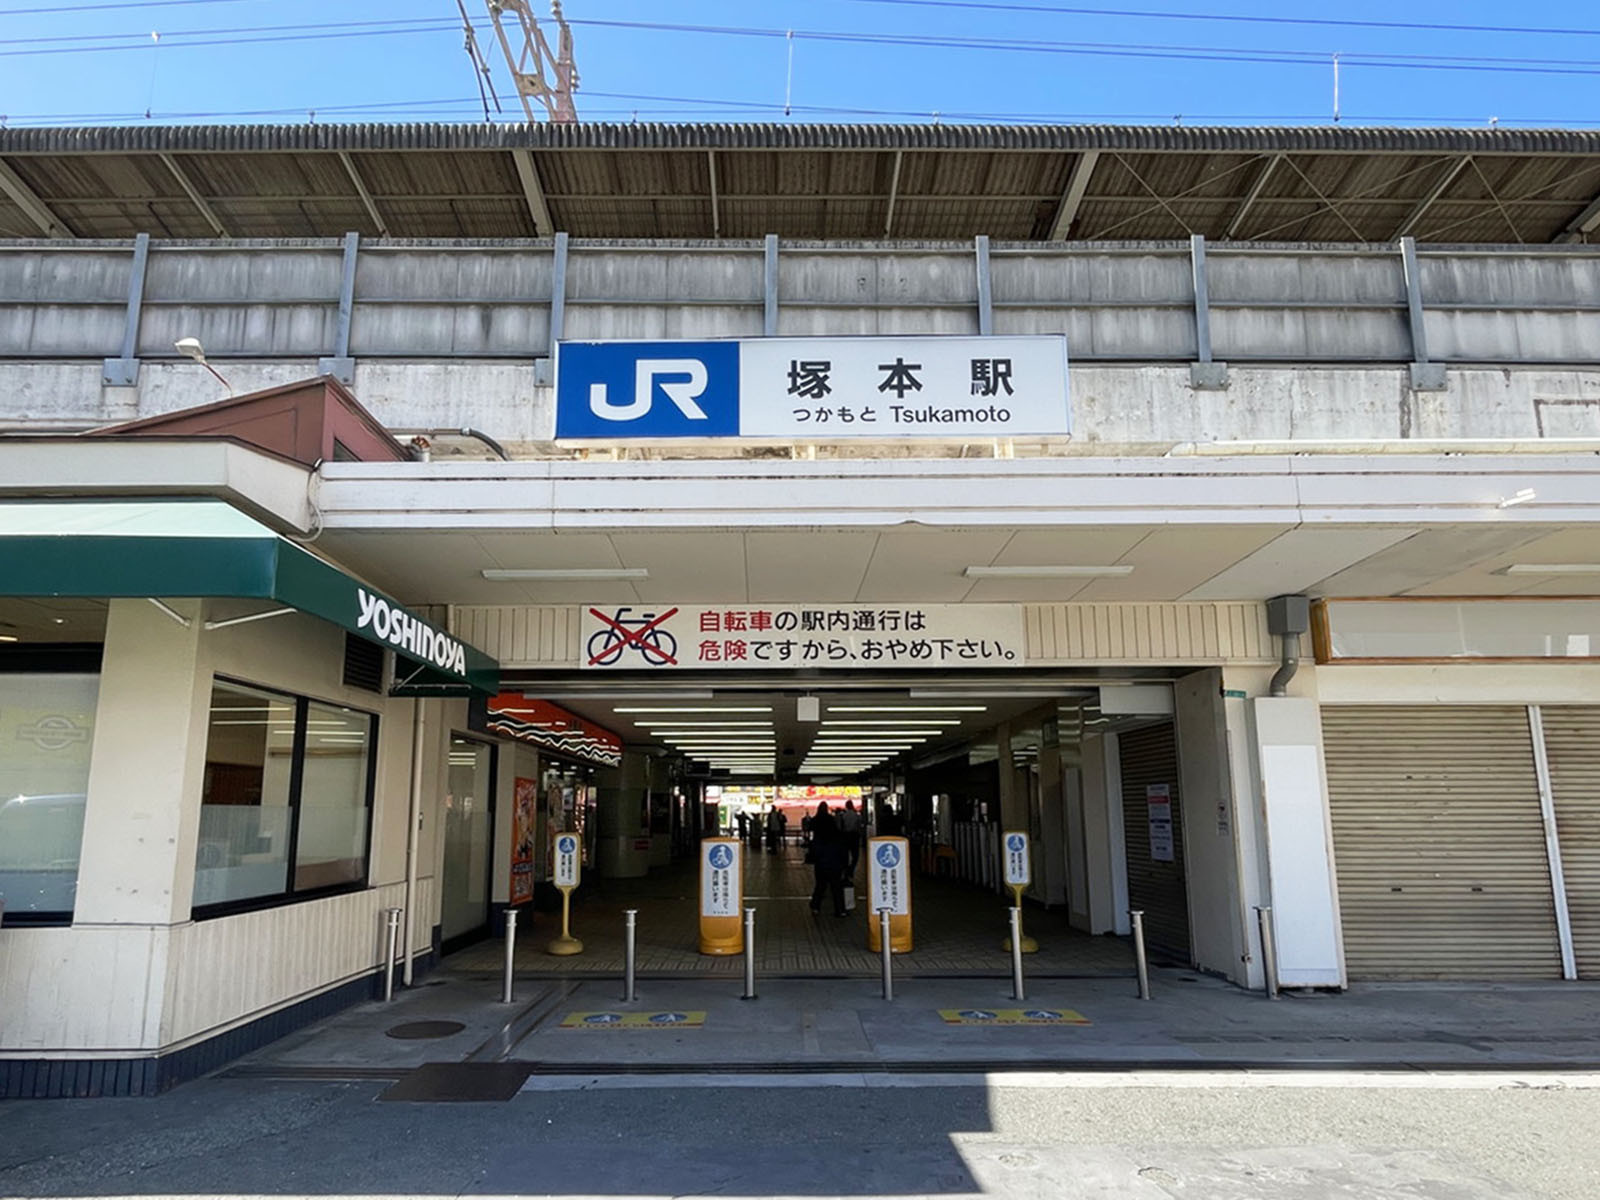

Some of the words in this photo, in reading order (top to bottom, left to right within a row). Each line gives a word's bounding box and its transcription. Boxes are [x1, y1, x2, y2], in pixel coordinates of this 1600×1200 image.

[589, 359, 709, 421] JR
[787, 358, 1014, 398] 塚本駅
[793, 406, 876, 423] つかもと
[889, 405, 1011, 423] Tsukamoto
[357, 588, 466, 677] YOSHINOYA
[699, 610, 926, 633] 自転車の駅内通行は
[698, 639, 1018, 661] 危険ですから、おやめ下さい。
